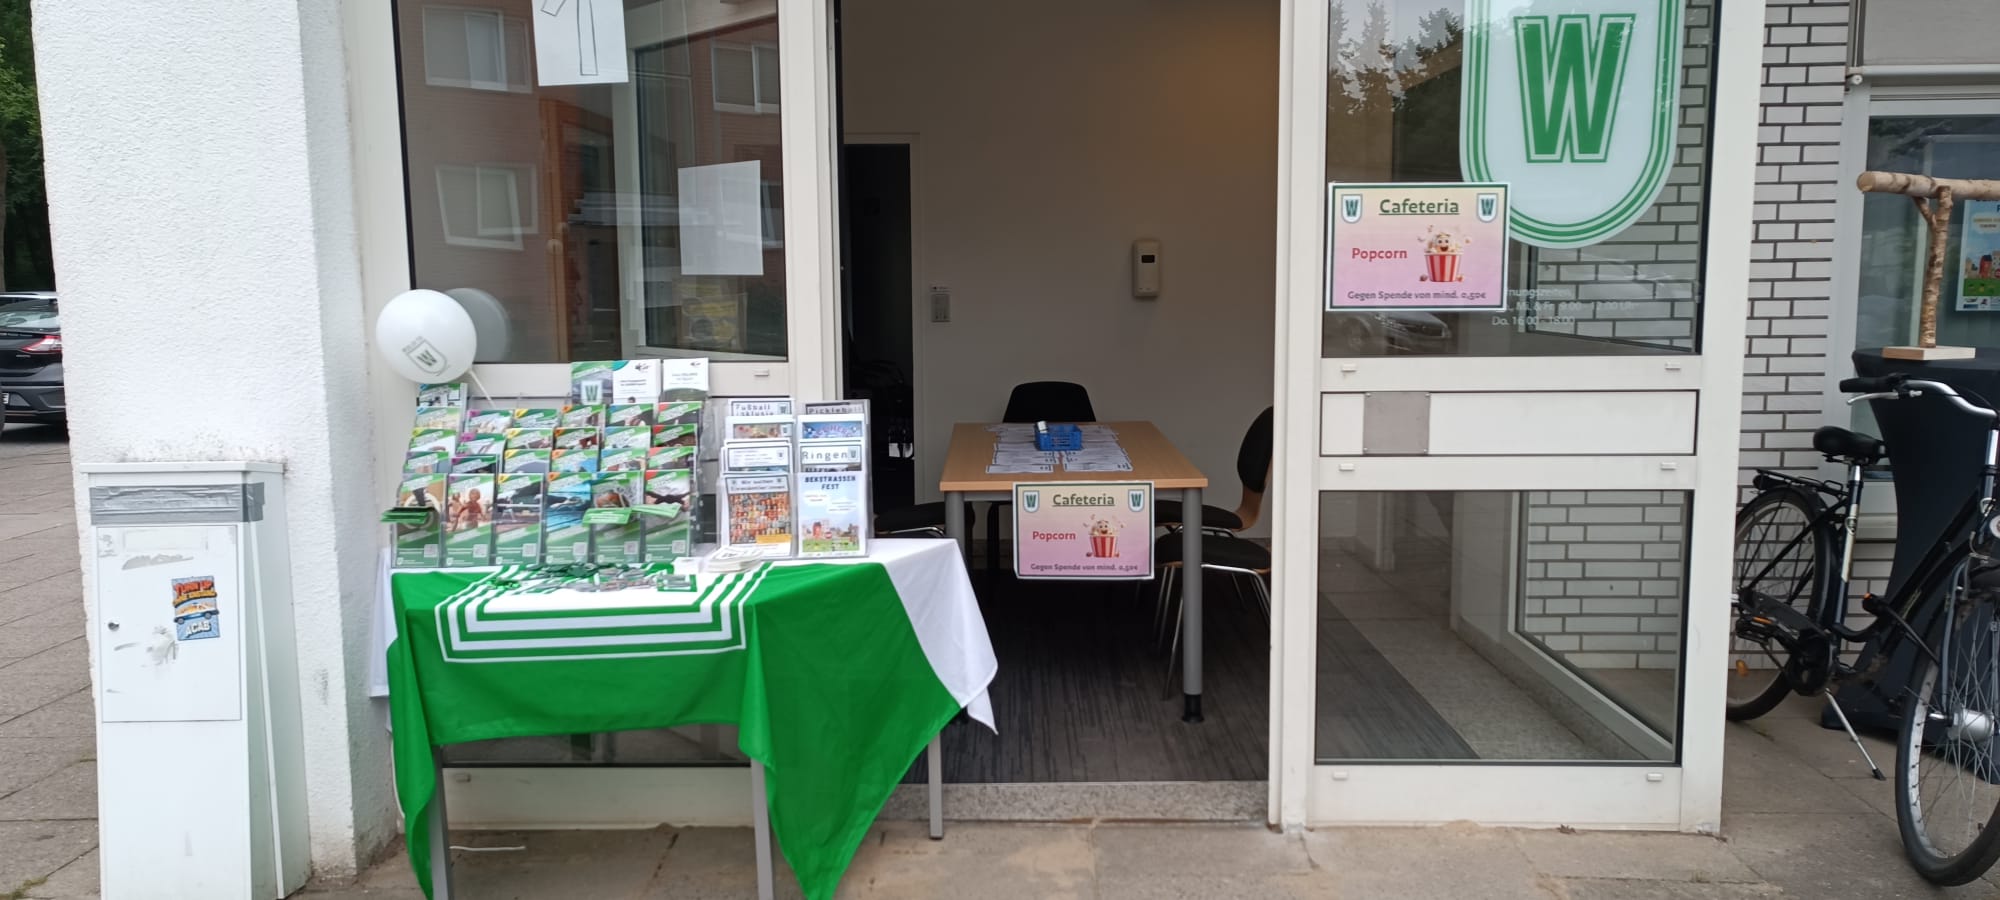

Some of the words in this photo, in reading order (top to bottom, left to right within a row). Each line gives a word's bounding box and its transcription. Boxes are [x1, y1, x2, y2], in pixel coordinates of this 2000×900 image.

[1514, 14, 1637, 163] W
[1345, 200, 1359, 217] W
[1379, 198, 1459, 214] Cafeteria
[1480, 198, 1494, 217] W
[1352, 248, 1408, 262] Popcorn
[1347, 291, 1376, 301] Gegen
[1378, 291, 1412, 300] Spende
[1433, 291, 1458, 299] mind.
[585, 385, 599, 402] W
[801, 451, 848, 461] Ringen
[1053, 493, 1115, 506] Cafeteria
[1033, 531, 1076, 542] Popcorn
[1030, 563, 1053, 571] Gegen
[1054, 563, 1080, 571] Spende
[186, 621, 211, 636] ACAB
